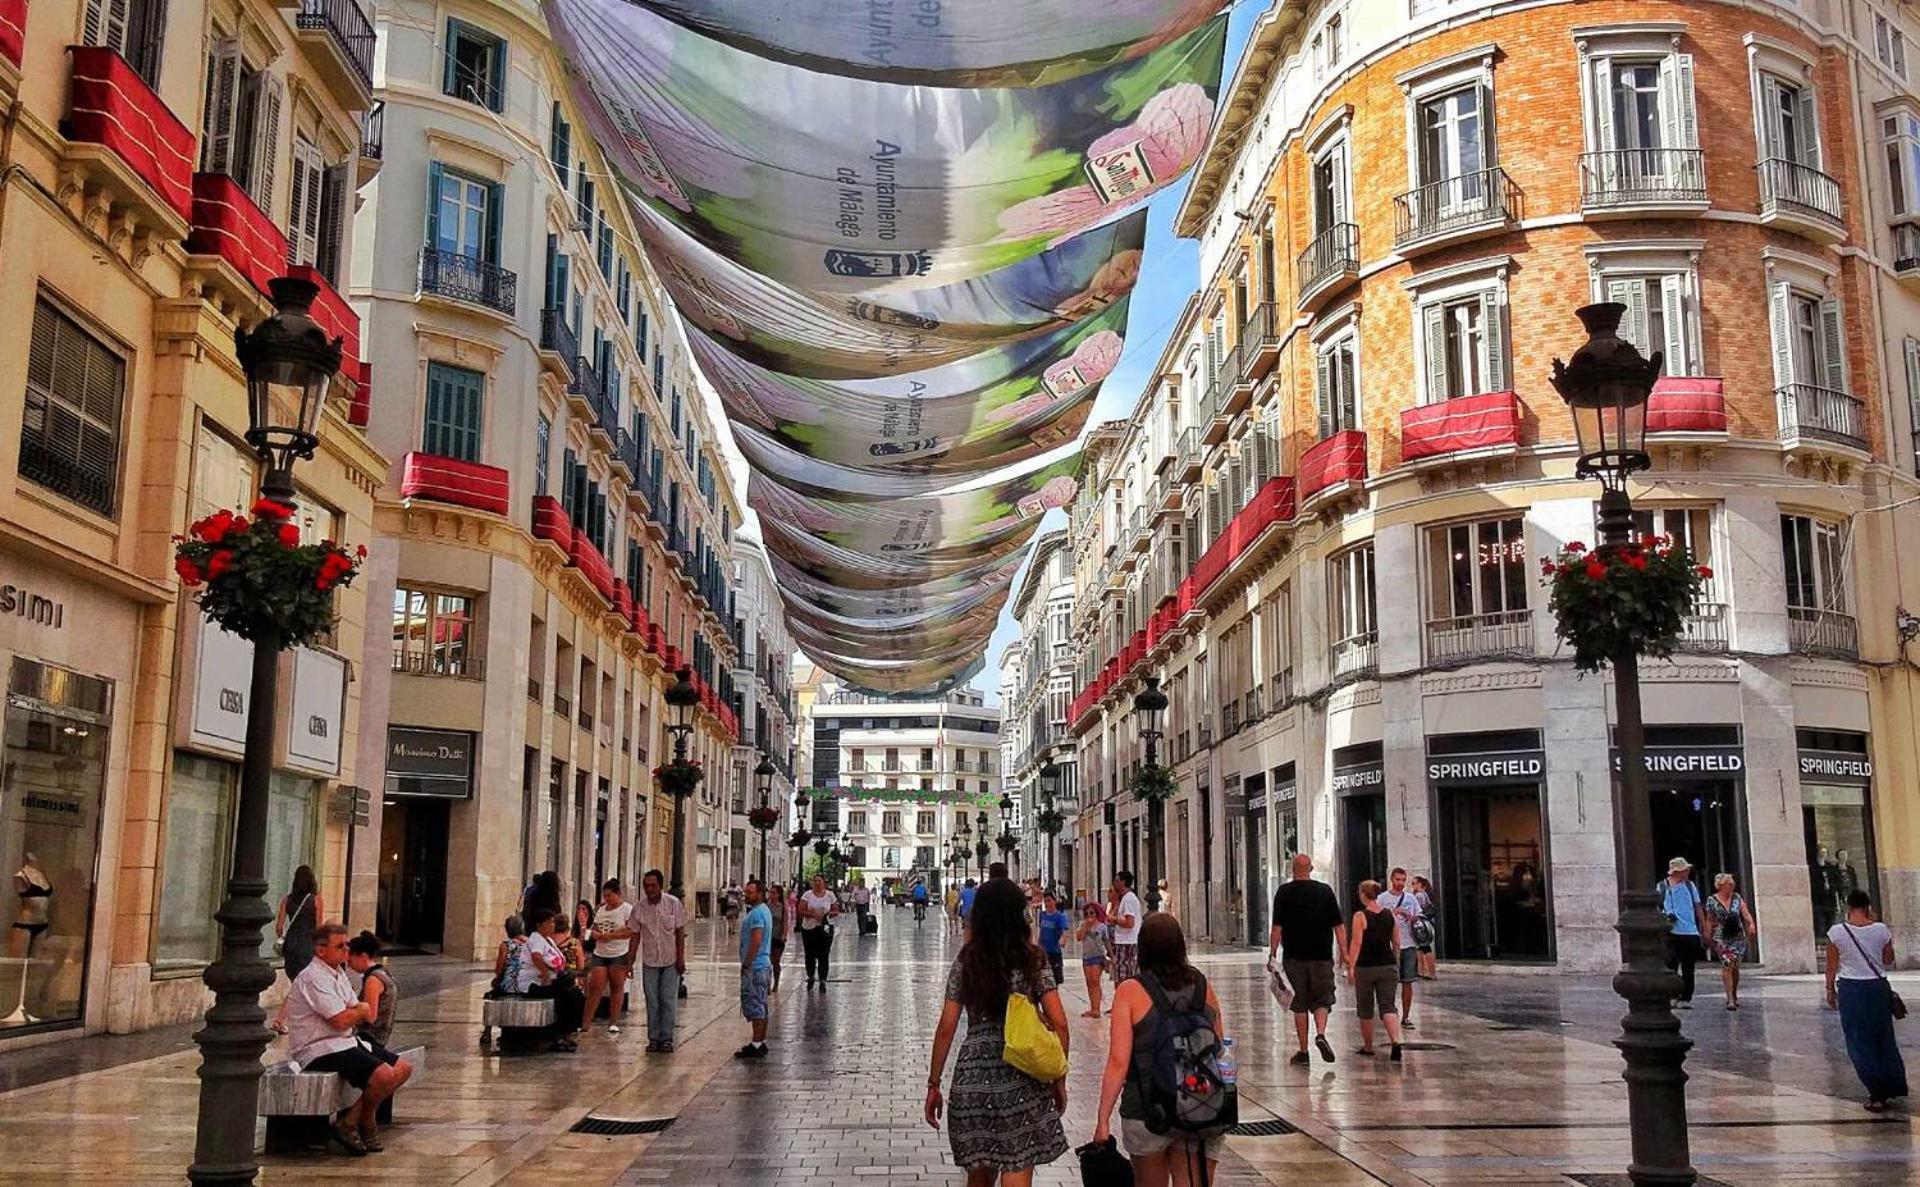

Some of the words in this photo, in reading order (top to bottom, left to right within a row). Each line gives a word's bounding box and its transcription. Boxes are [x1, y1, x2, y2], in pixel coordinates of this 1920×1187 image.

[837, 167, 861, 185] de
[869, 139, 901, 240] Ayuntamiento
[835, 188, 864, 238] Málaga
[1429, 760, 1541, 779] SPRINGFIELD
[1800, 757, 1873, 777] SPRINGFIELD
[1333, 769, 1382, 791] SPRINGFIELD
